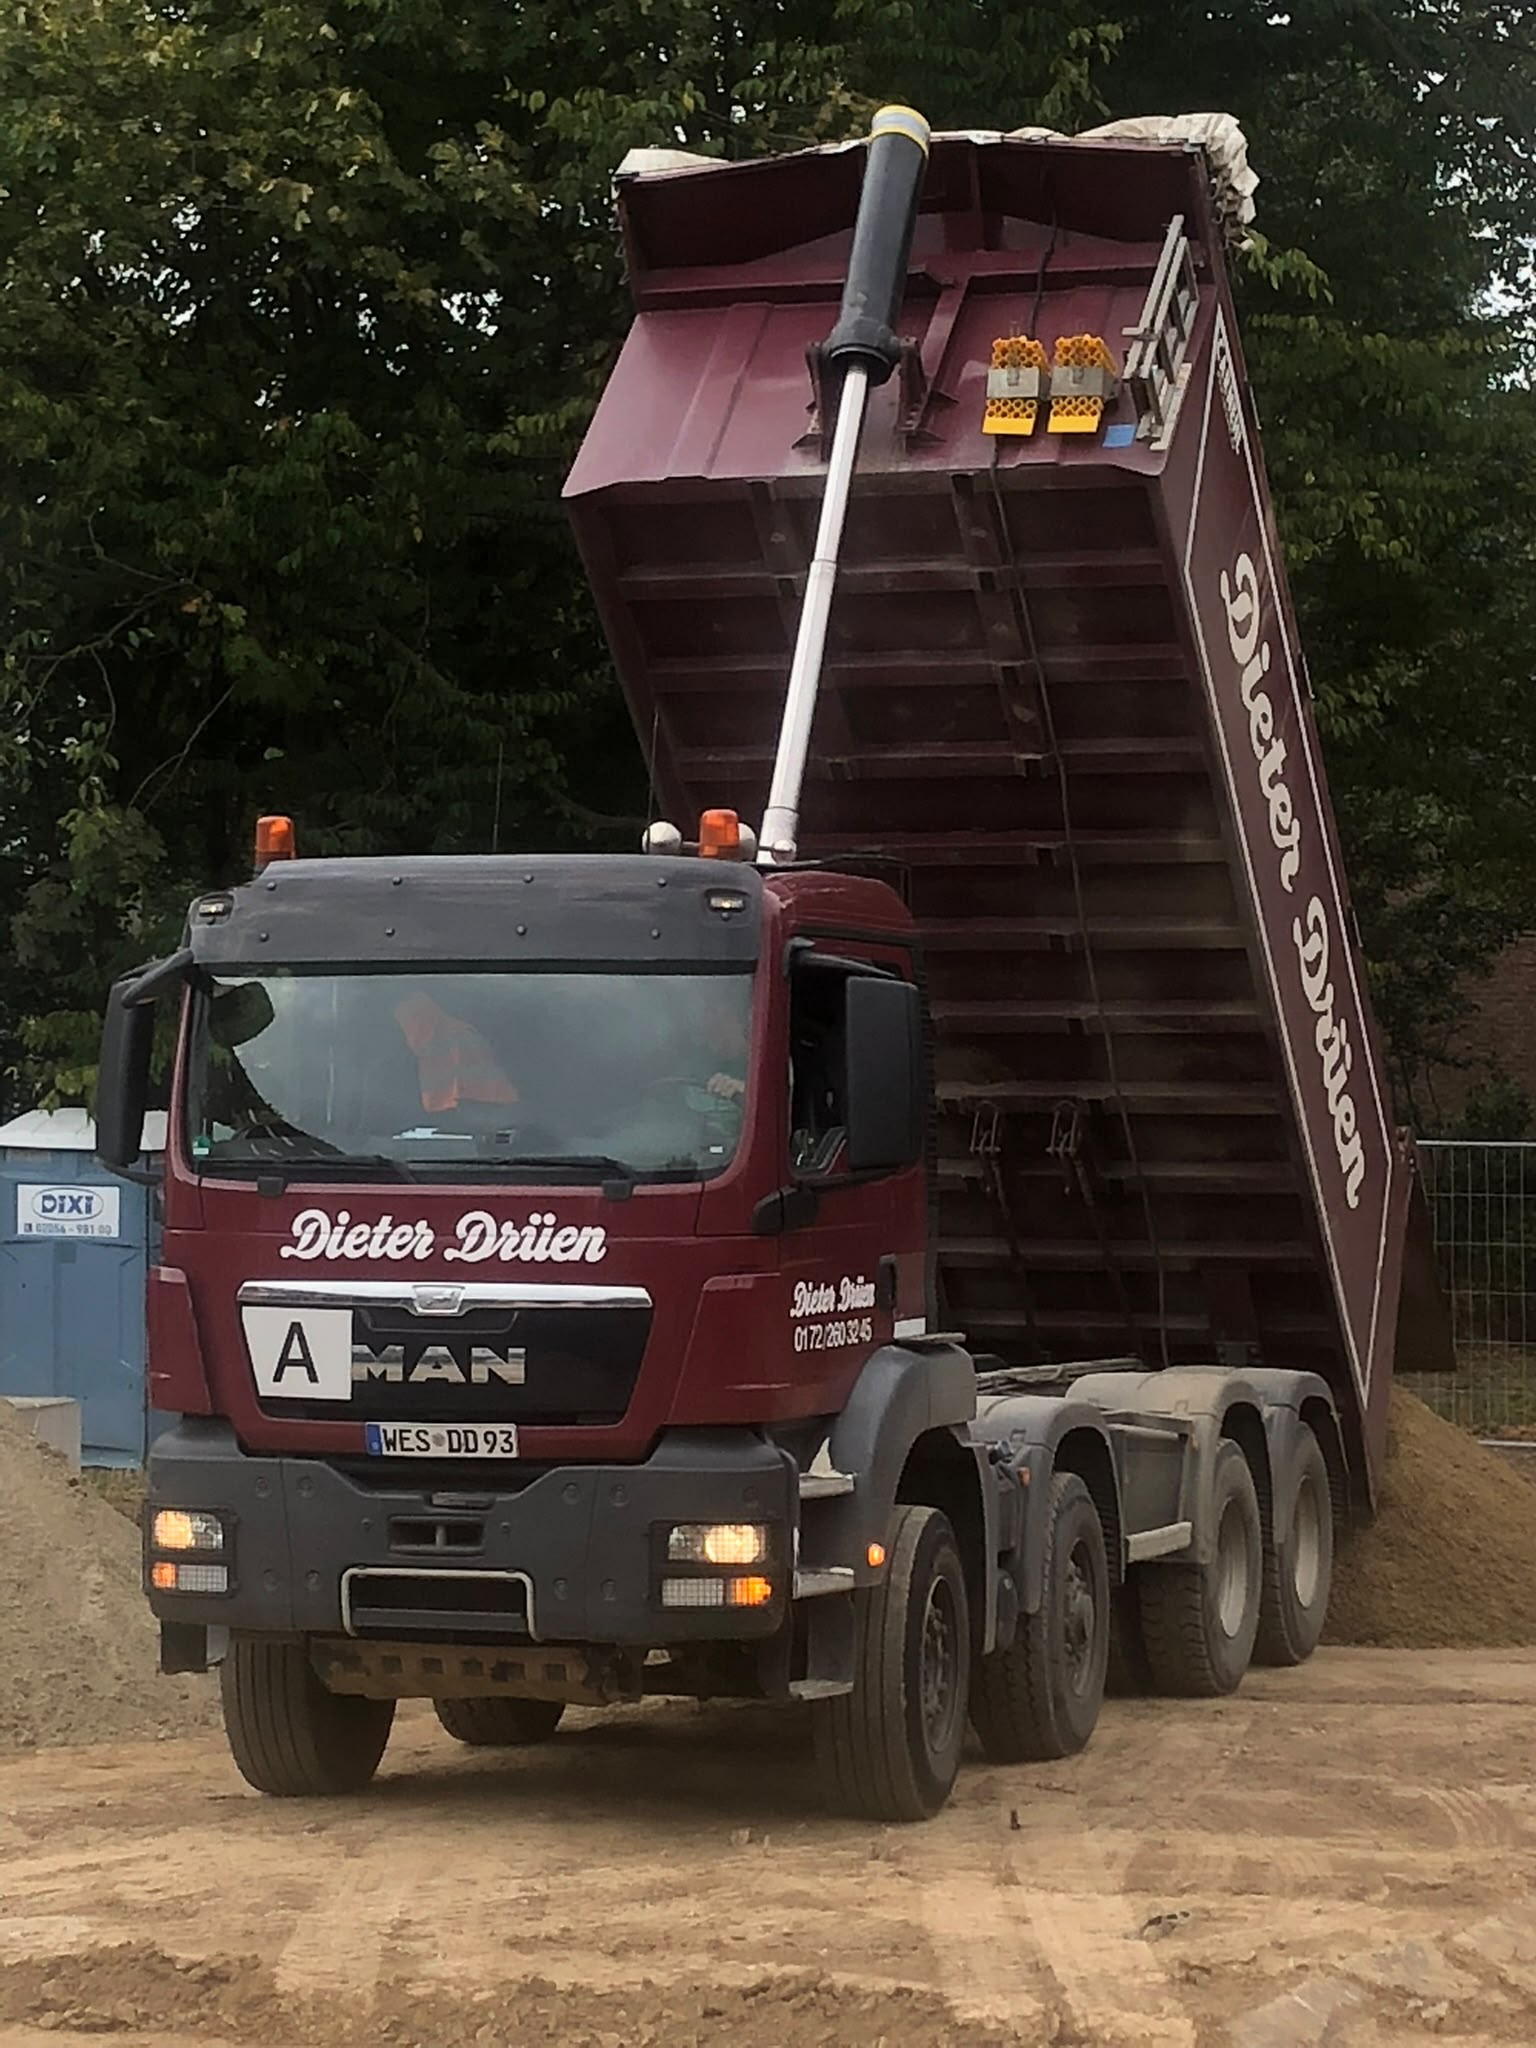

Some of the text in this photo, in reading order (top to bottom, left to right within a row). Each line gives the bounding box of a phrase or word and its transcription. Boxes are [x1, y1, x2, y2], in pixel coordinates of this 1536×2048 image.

[1219, 552, 1367, 1210] Dieter Drüen
[279, 1208, 608, 1263] Dieter Drüen
[789, 1280, 836, 1318] Dieter
[271, 1321, 320, 1385] A
[351, 1344, 526, 1385] MAN
[382, 1428, 431, 1453] WES
